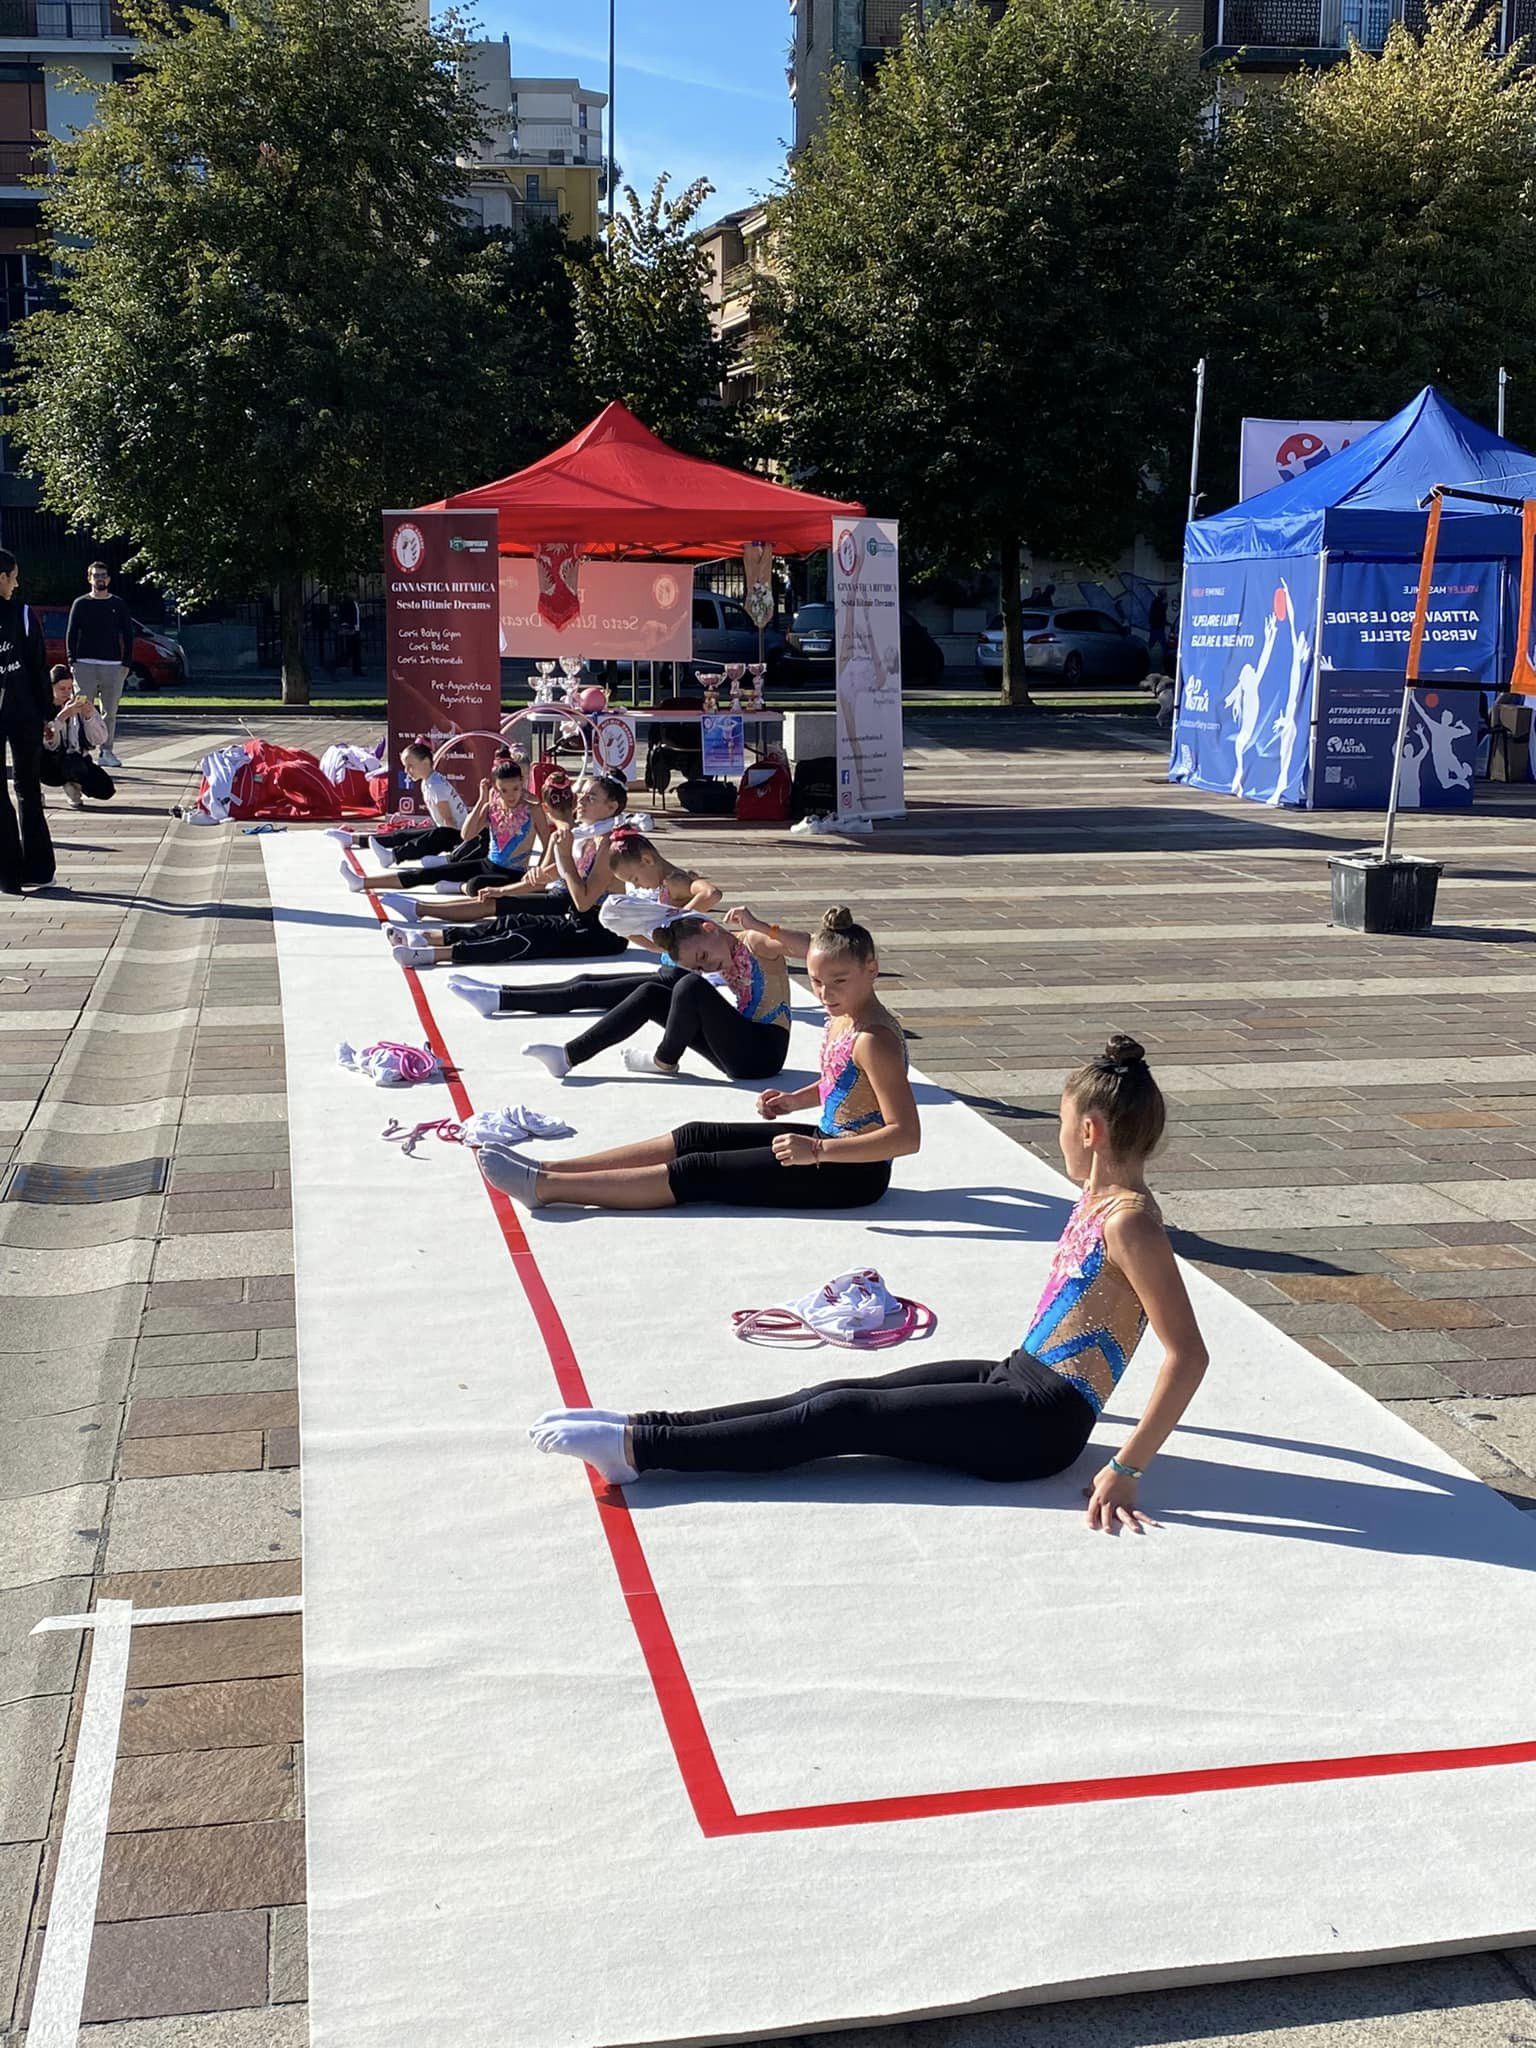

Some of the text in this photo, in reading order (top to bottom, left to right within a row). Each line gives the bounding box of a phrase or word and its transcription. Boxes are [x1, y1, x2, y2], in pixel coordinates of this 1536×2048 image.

[391, 582, 496, 592] GINNASTICA RITMICA
[396, 600, 491, 610] Sesto Ritmic Dreams
[1328, 717, 1353, 725] VERSO
[1353, 717, 1363, 725] LE
[1343, 738, 1355, 746] AD
